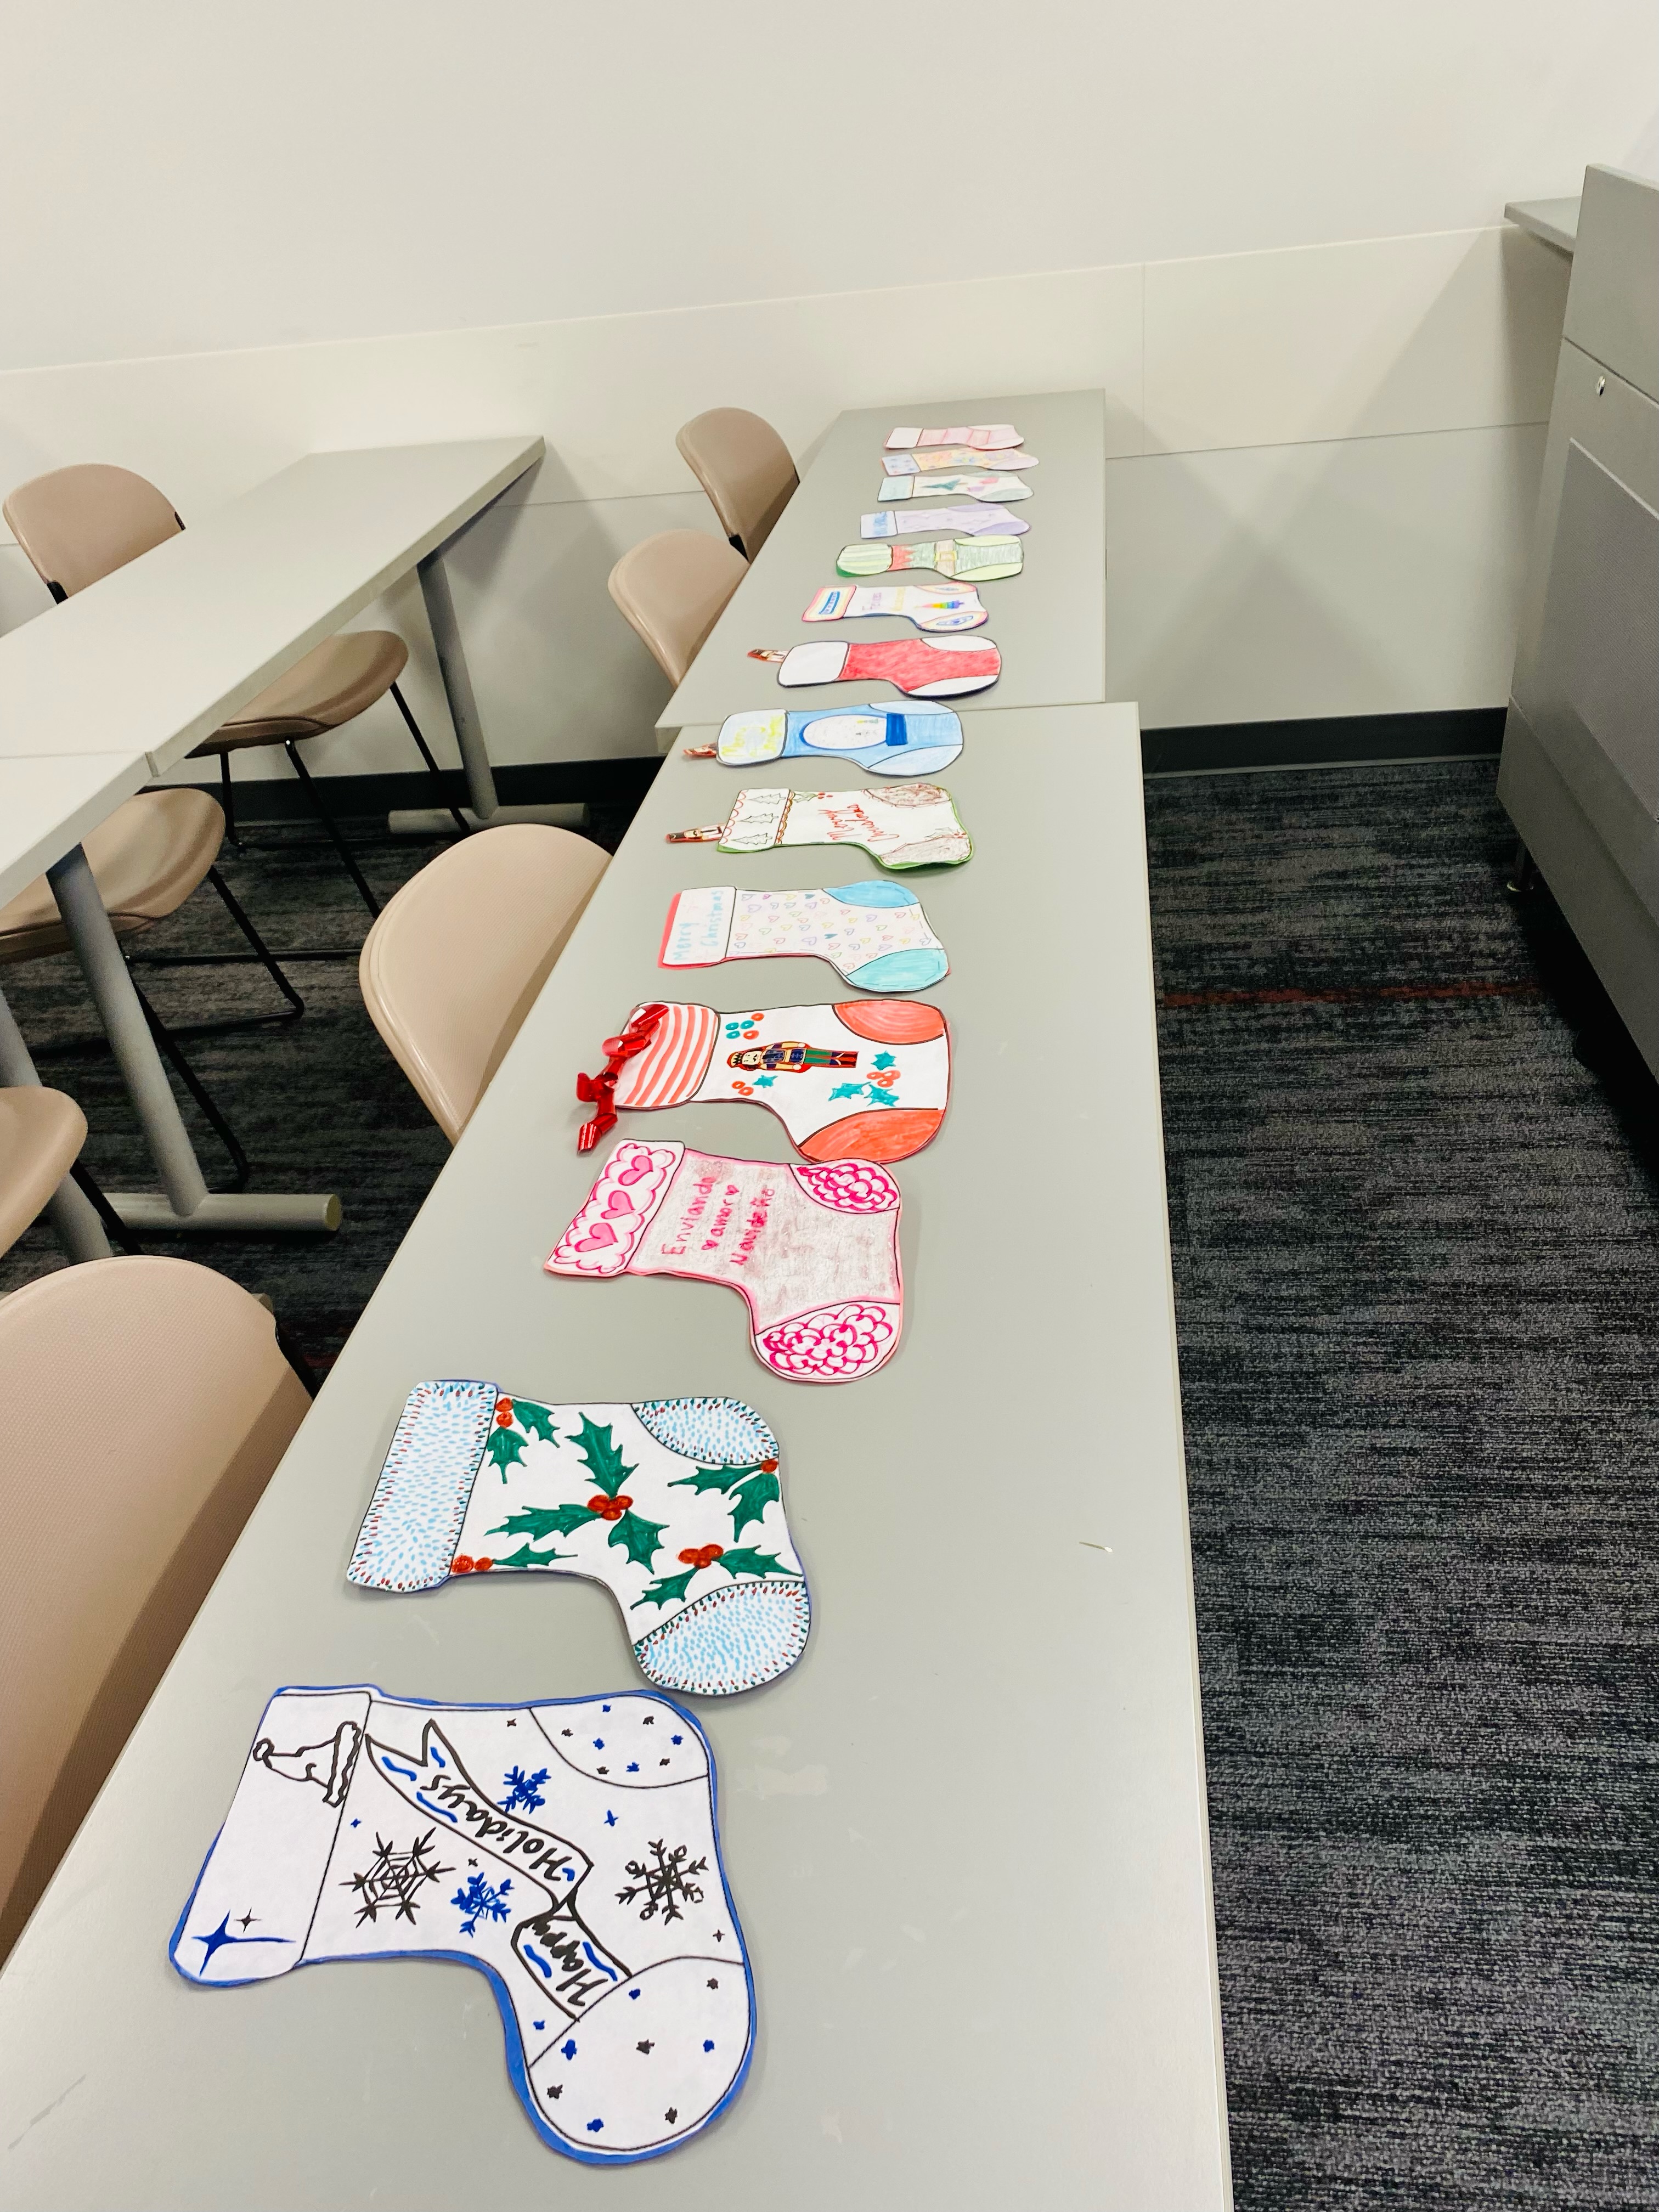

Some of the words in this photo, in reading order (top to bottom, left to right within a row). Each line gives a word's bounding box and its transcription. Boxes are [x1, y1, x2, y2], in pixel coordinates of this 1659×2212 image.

[673, 923, 699, 961] Merry
[699, 890, 724, 947] Christmas
[661, 1176, 716, 1255] Enviando
[710, 1199, 733, 1237] amor
[419, 1775, 572, 1881] Holidays
